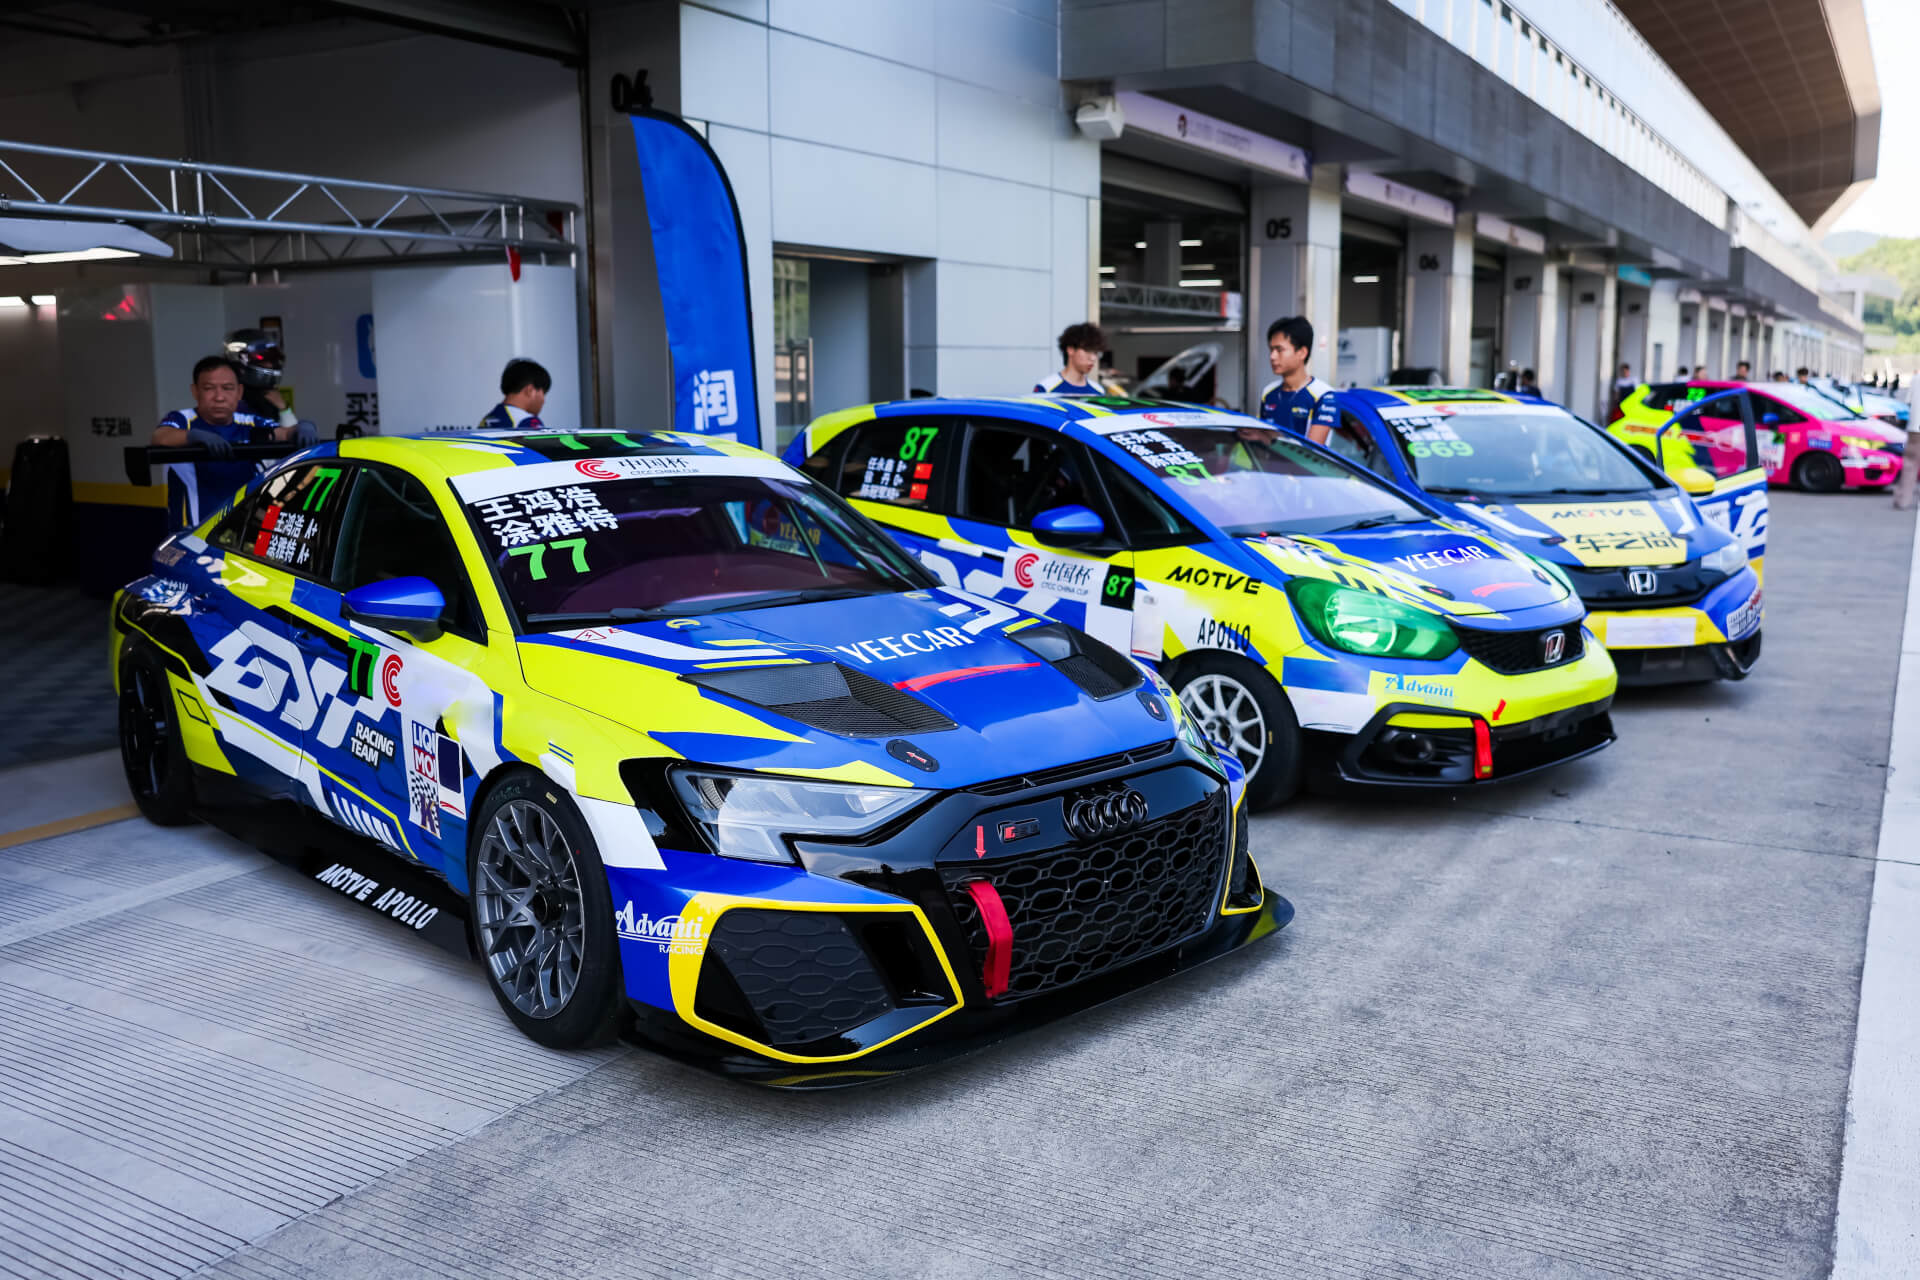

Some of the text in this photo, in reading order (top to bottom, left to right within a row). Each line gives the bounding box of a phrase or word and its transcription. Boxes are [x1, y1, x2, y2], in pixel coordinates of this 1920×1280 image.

[1266, 218, 1291, 240] 05
[1418, 254, 1439, 271] 06
[693, 369, 738, 440] 润
[523, 433, 645, 450] 77
[899, 426, 939, 460] 87
[1407, 440, 1474, 458] 669
[1165, 463, 1218, 486] 87
[302, 468, 342, 512] 77
[474, 486, 601, 523] 王鸿浩
[273, 511, 318, 540] 王鸿浩 A+
[490, 507, 619, 547] 涂雅特
[296, 543, 310, 565] A+
[507, 538, 590, 581] 77
[1394, 545, 1491, 574] YEECAR
[1042, 560, 1094, 586] 中国杯
[1105, 574, 1133, 598] 87
[1165, 565, 1262, 596] MOTVE
[834, 626, 975, 664] YEECAR
[1197, 617, 1251, 652] APOLLO
[347, 635, 380, 698] 77
[1384, 672, 1454, 697] Advanti
[350, 737, 379, 767] TEAM
[355, 721, 395, 757] RACING
[412, 723, 436, 752] LIQ
[315, 863, 379, 901] MOTVE
[372, 887, 439, 929] APOLLO
[615, 900, 703, 938] Advanti
[658, 944, 704, 955] RACING
